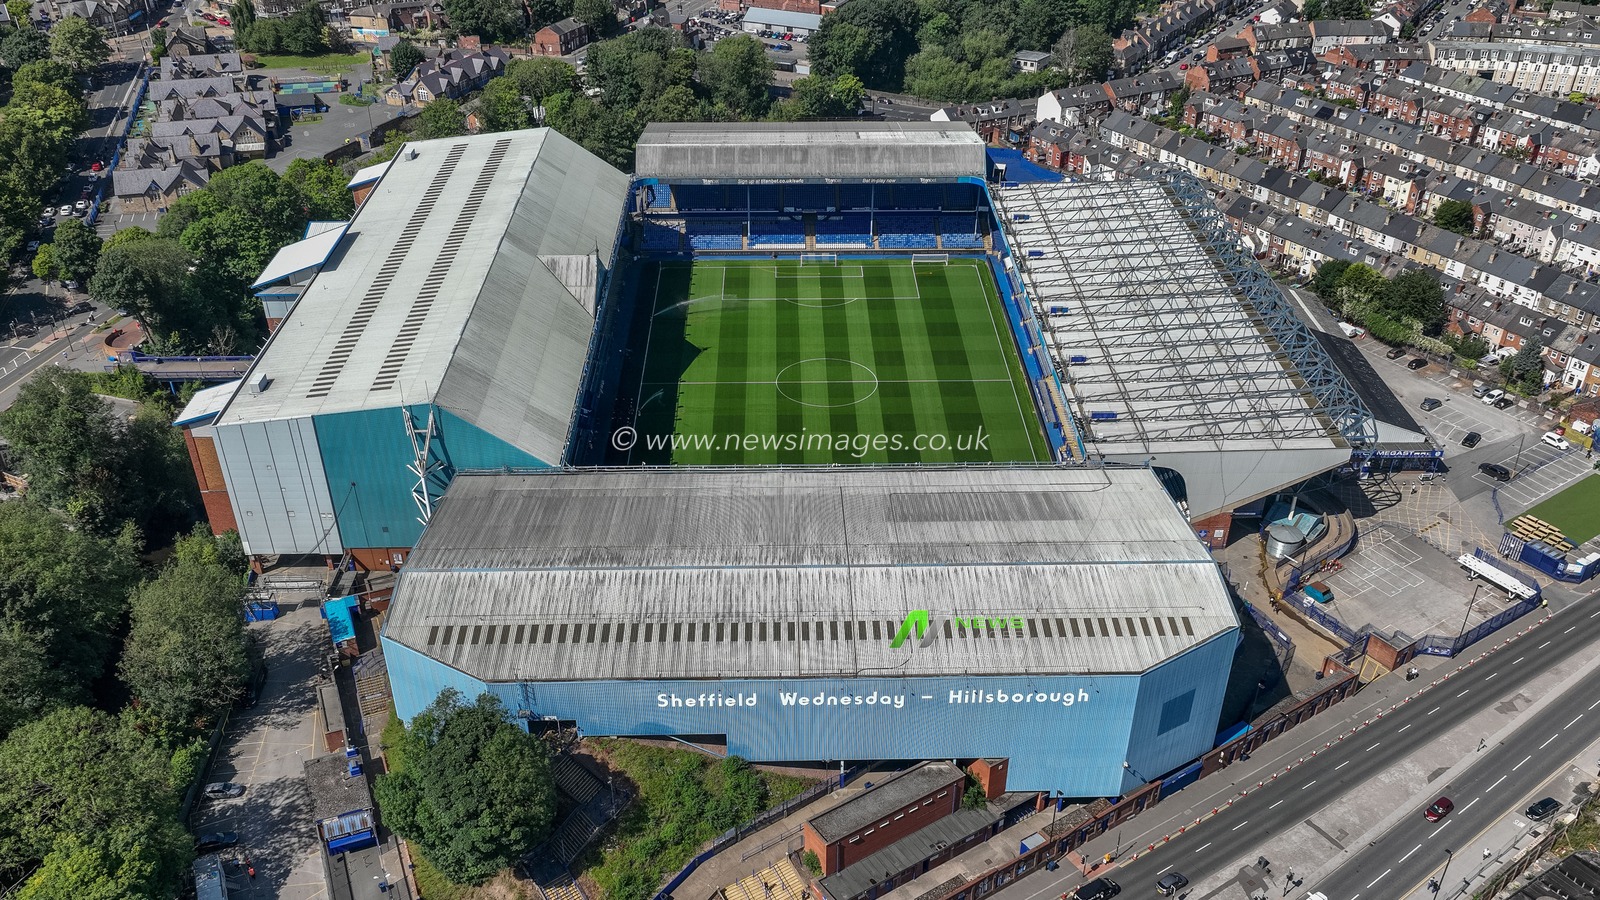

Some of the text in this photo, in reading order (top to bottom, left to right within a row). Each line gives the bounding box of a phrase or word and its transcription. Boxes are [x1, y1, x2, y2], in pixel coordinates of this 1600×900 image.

[657, 692, 758, 708] Sheffield
[779, 691, 906, 709] Wednesday
[948, 688, 1090, 707] Hillsborough
